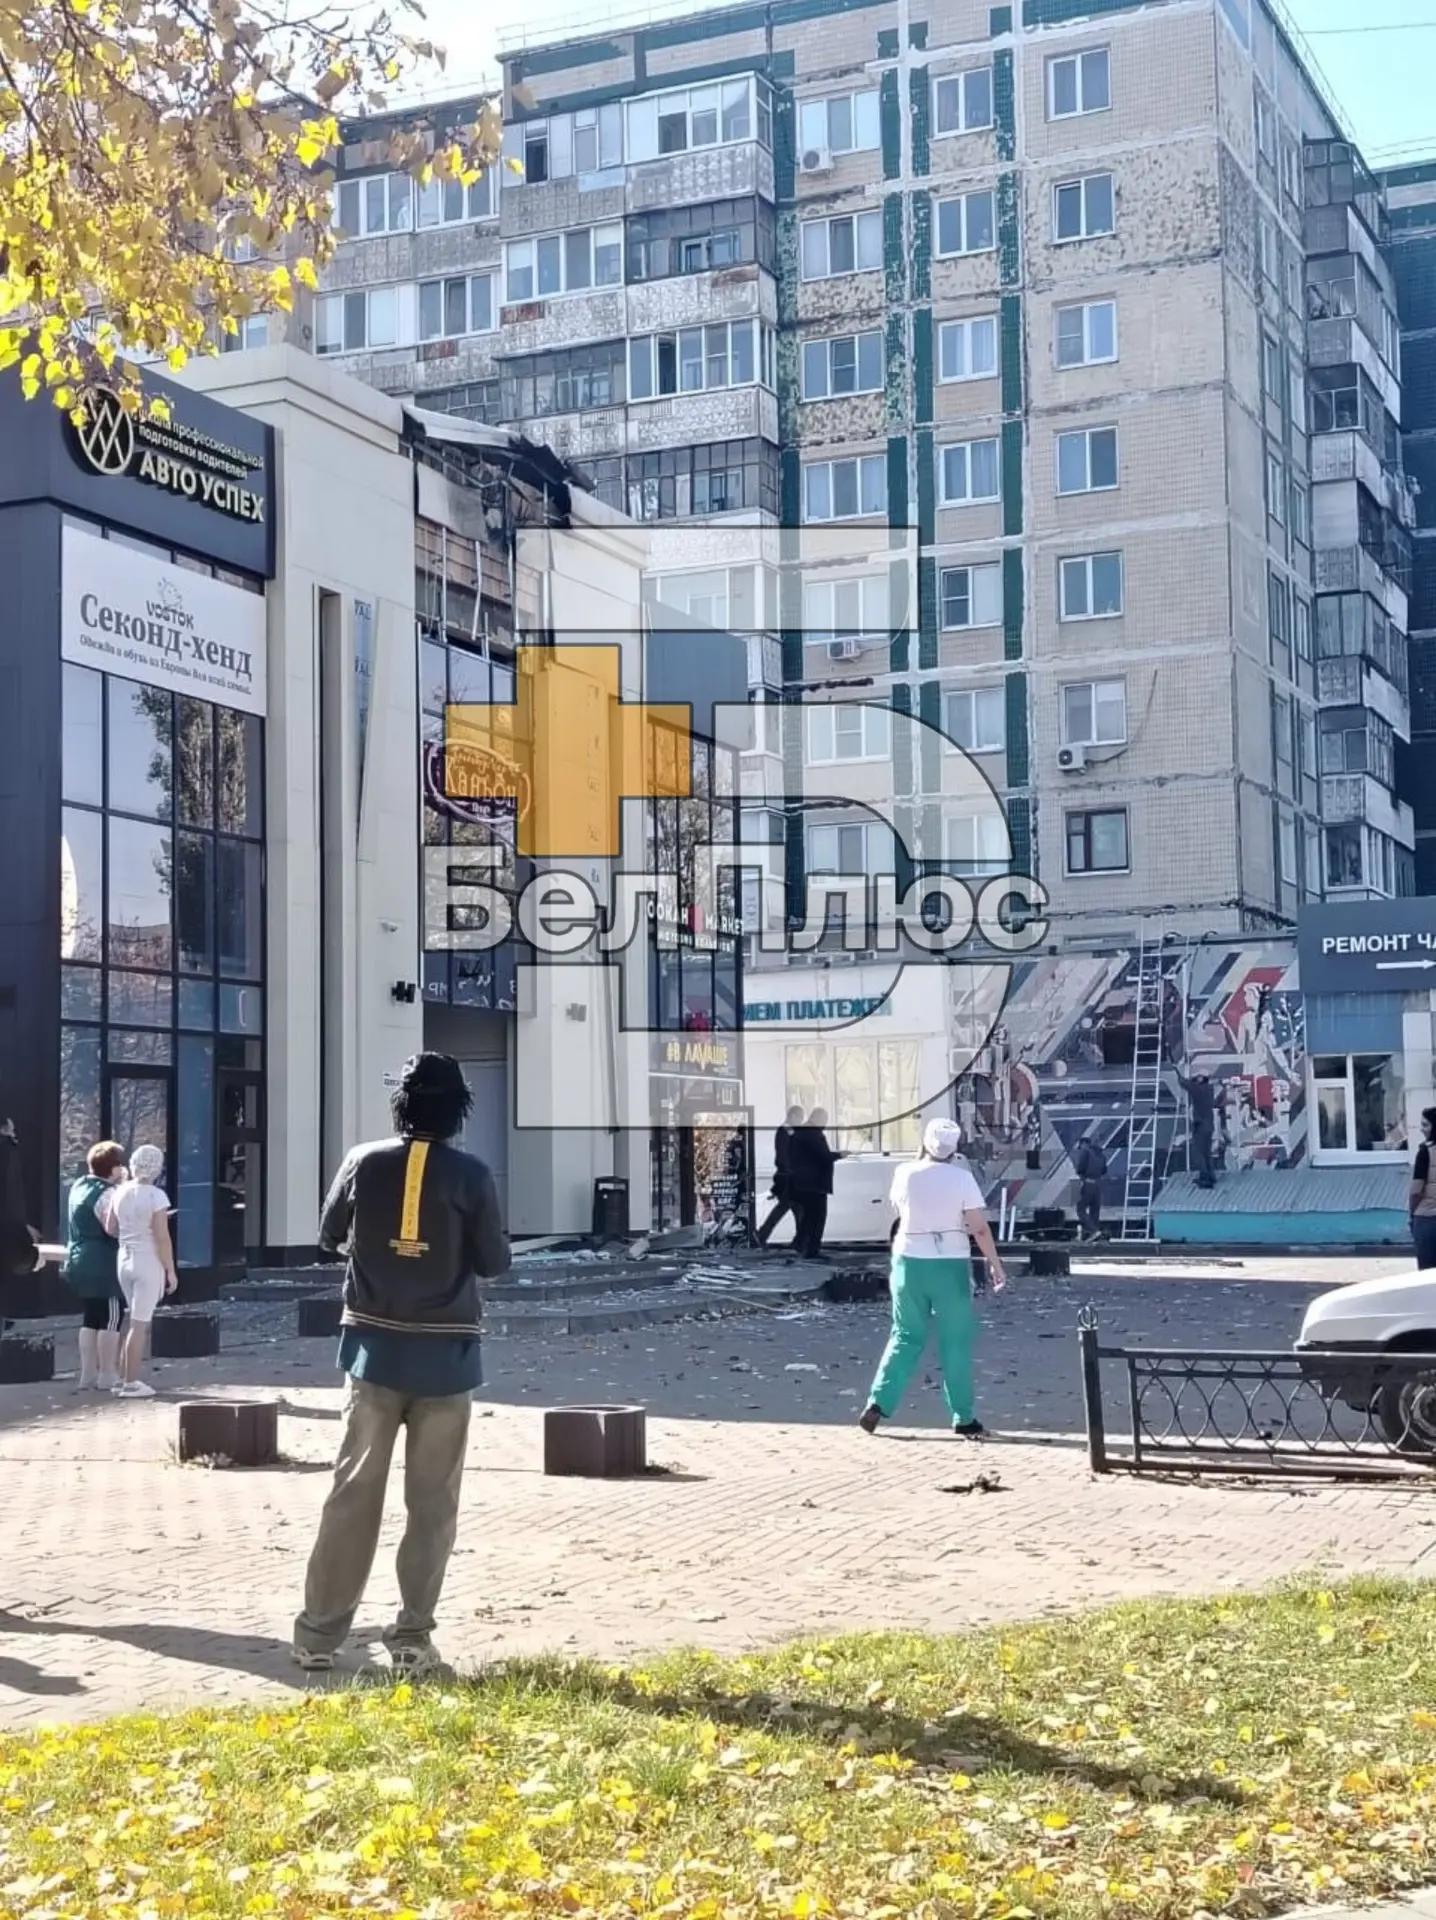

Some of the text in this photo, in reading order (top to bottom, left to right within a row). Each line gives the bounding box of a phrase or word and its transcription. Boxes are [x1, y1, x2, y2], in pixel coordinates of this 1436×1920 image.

[139, 424, 247, 480] подготовки водителей
[173, 421, 264, 470] профессиональной
[146, 599, 194, 630] VOSTOK
[80, 593, 252, 683] Секонд-хенд
[1322, 933, 1411, 954] РЕМОНТ
[787, 993, 892, 1020] ПЛАТЕЖЕЙ
